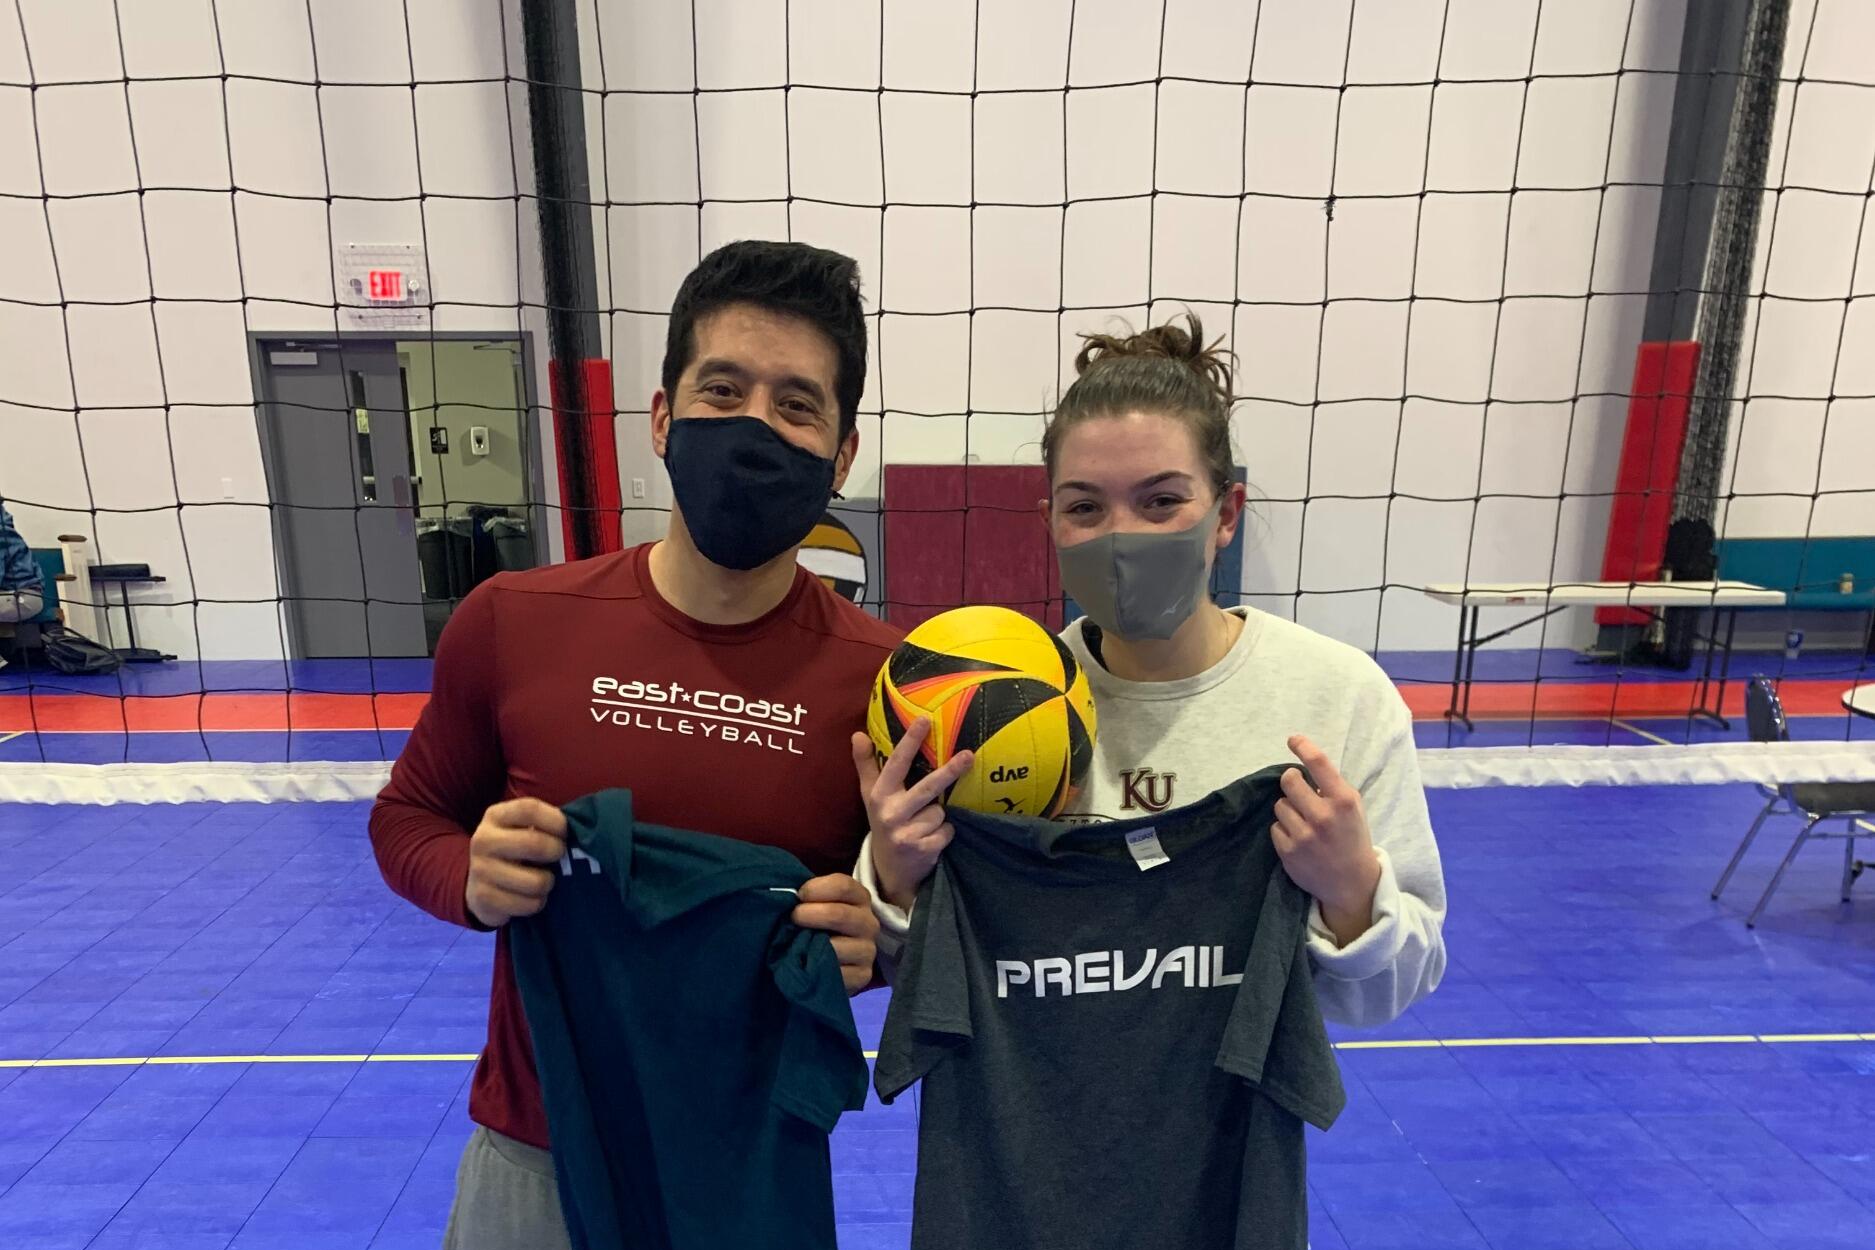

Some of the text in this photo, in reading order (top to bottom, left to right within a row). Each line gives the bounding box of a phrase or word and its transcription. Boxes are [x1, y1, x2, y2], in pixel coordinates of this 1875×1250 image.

[368, 271, 401, 298] EXIT
[590, 707, 803, 755] VOLLEYBALL
[989, 765, 1030, 784] avp
[1119, 767, 1176, 812] KU
[995, 945, 1244, 998] PREVAIL
